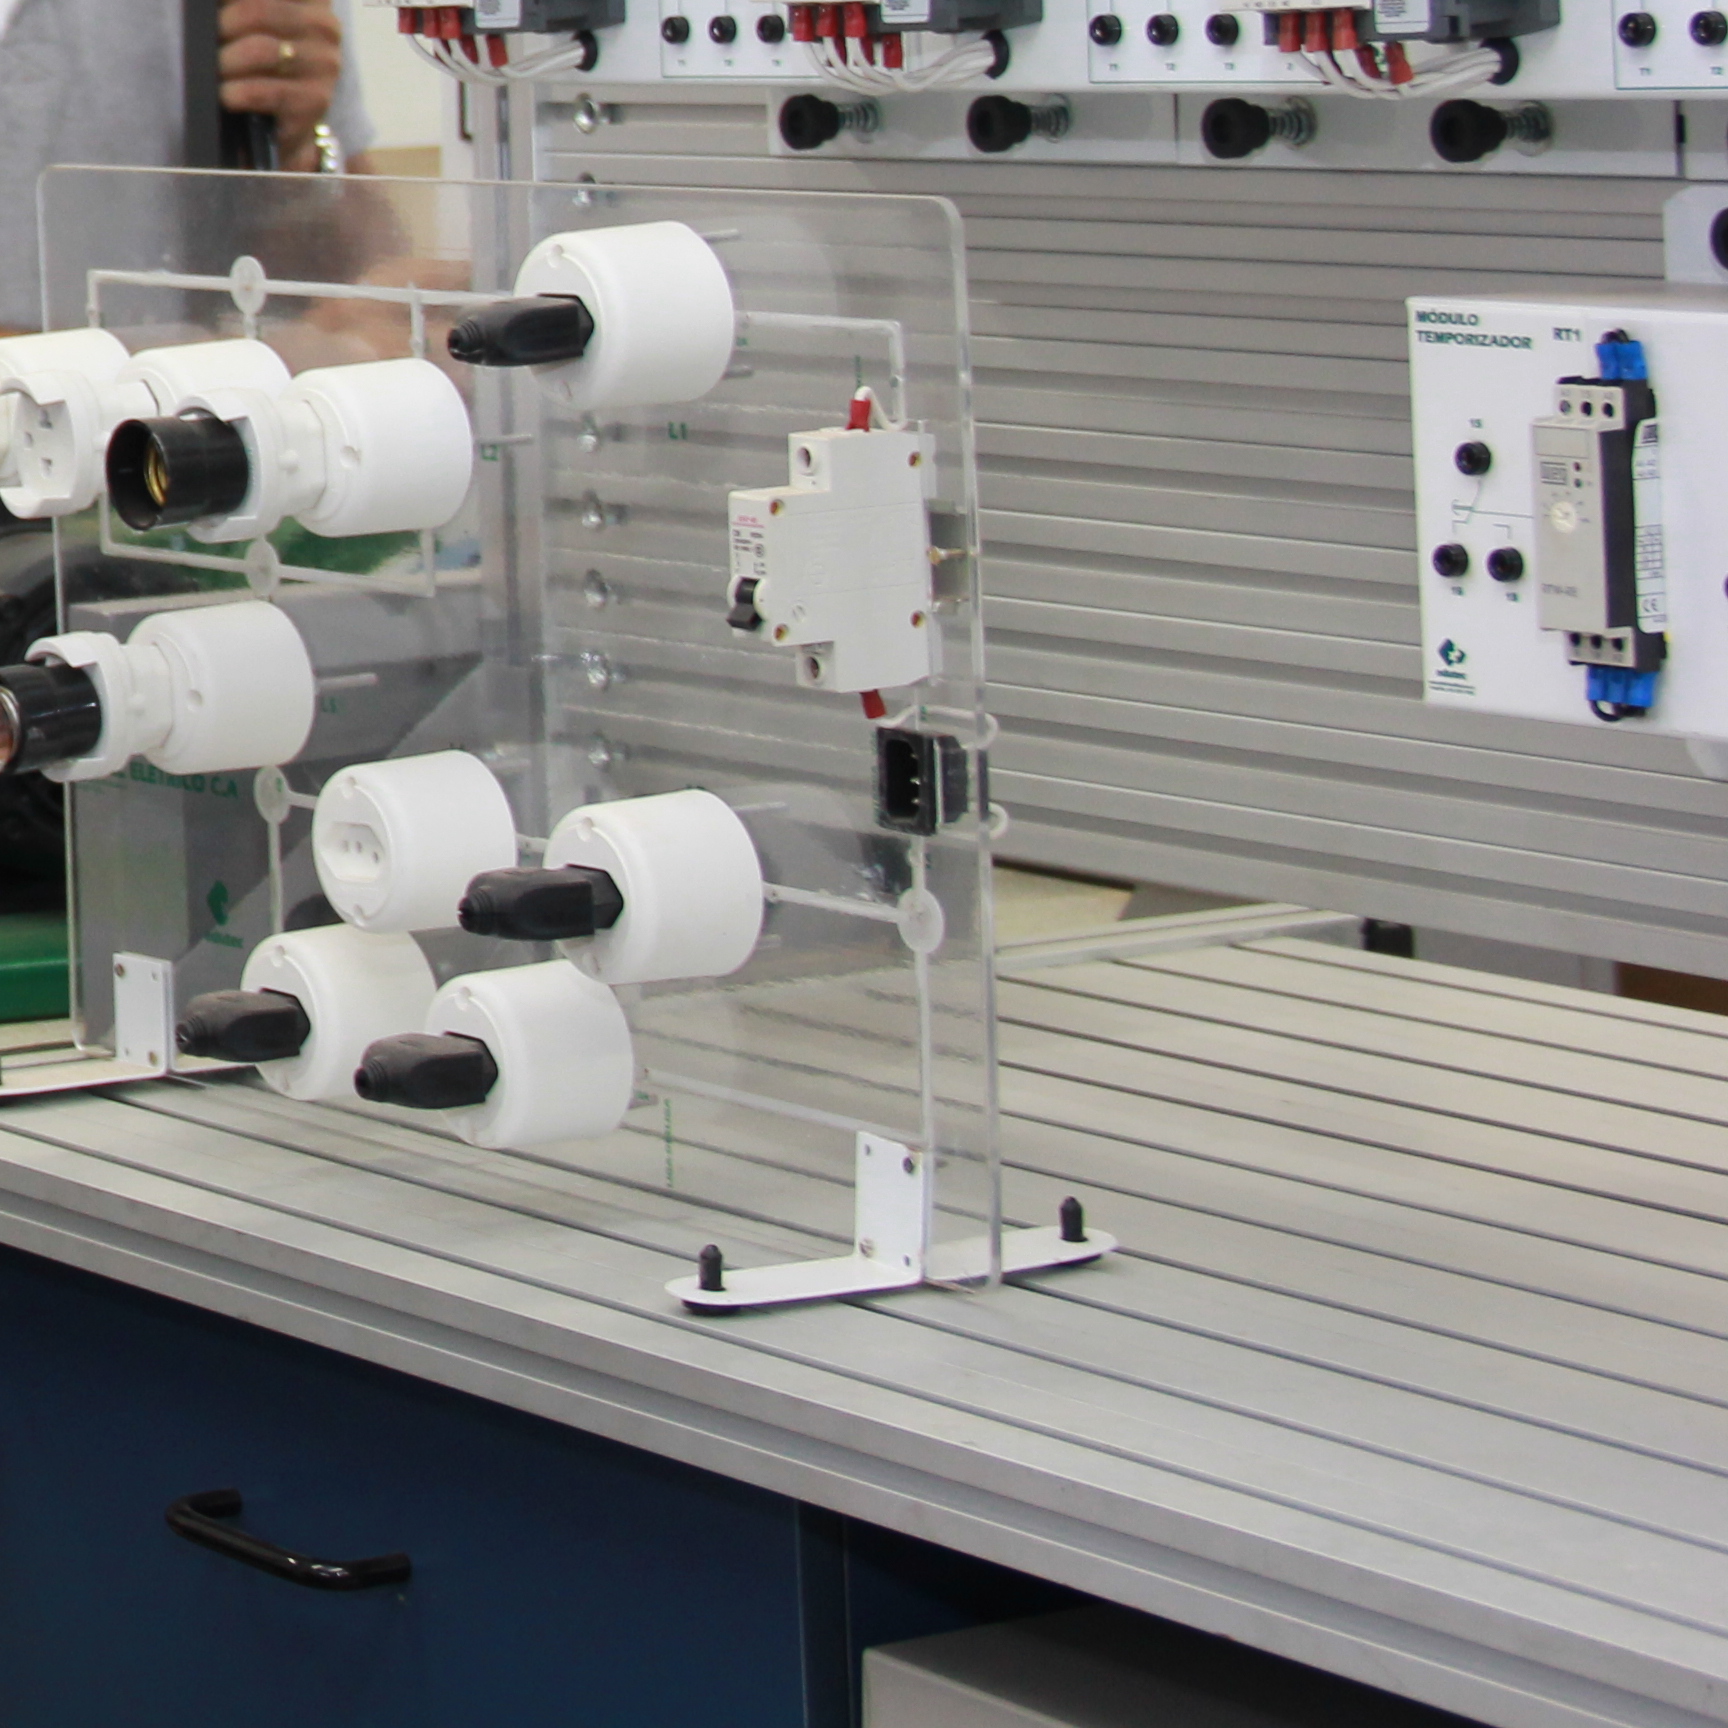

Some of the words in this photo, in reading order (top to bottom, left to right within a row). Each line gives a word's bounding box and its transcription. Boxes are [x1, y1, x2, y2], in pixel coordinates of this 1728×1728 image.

[1416, 308, 1480, 326] MÓDULO
[1416, 330, 1533, 349] TEMPORIZADOR
[1553, 327, 1582, 341] RT1
[669, 422, 688, 440] L1
[480, 444, 498, 461] L2
